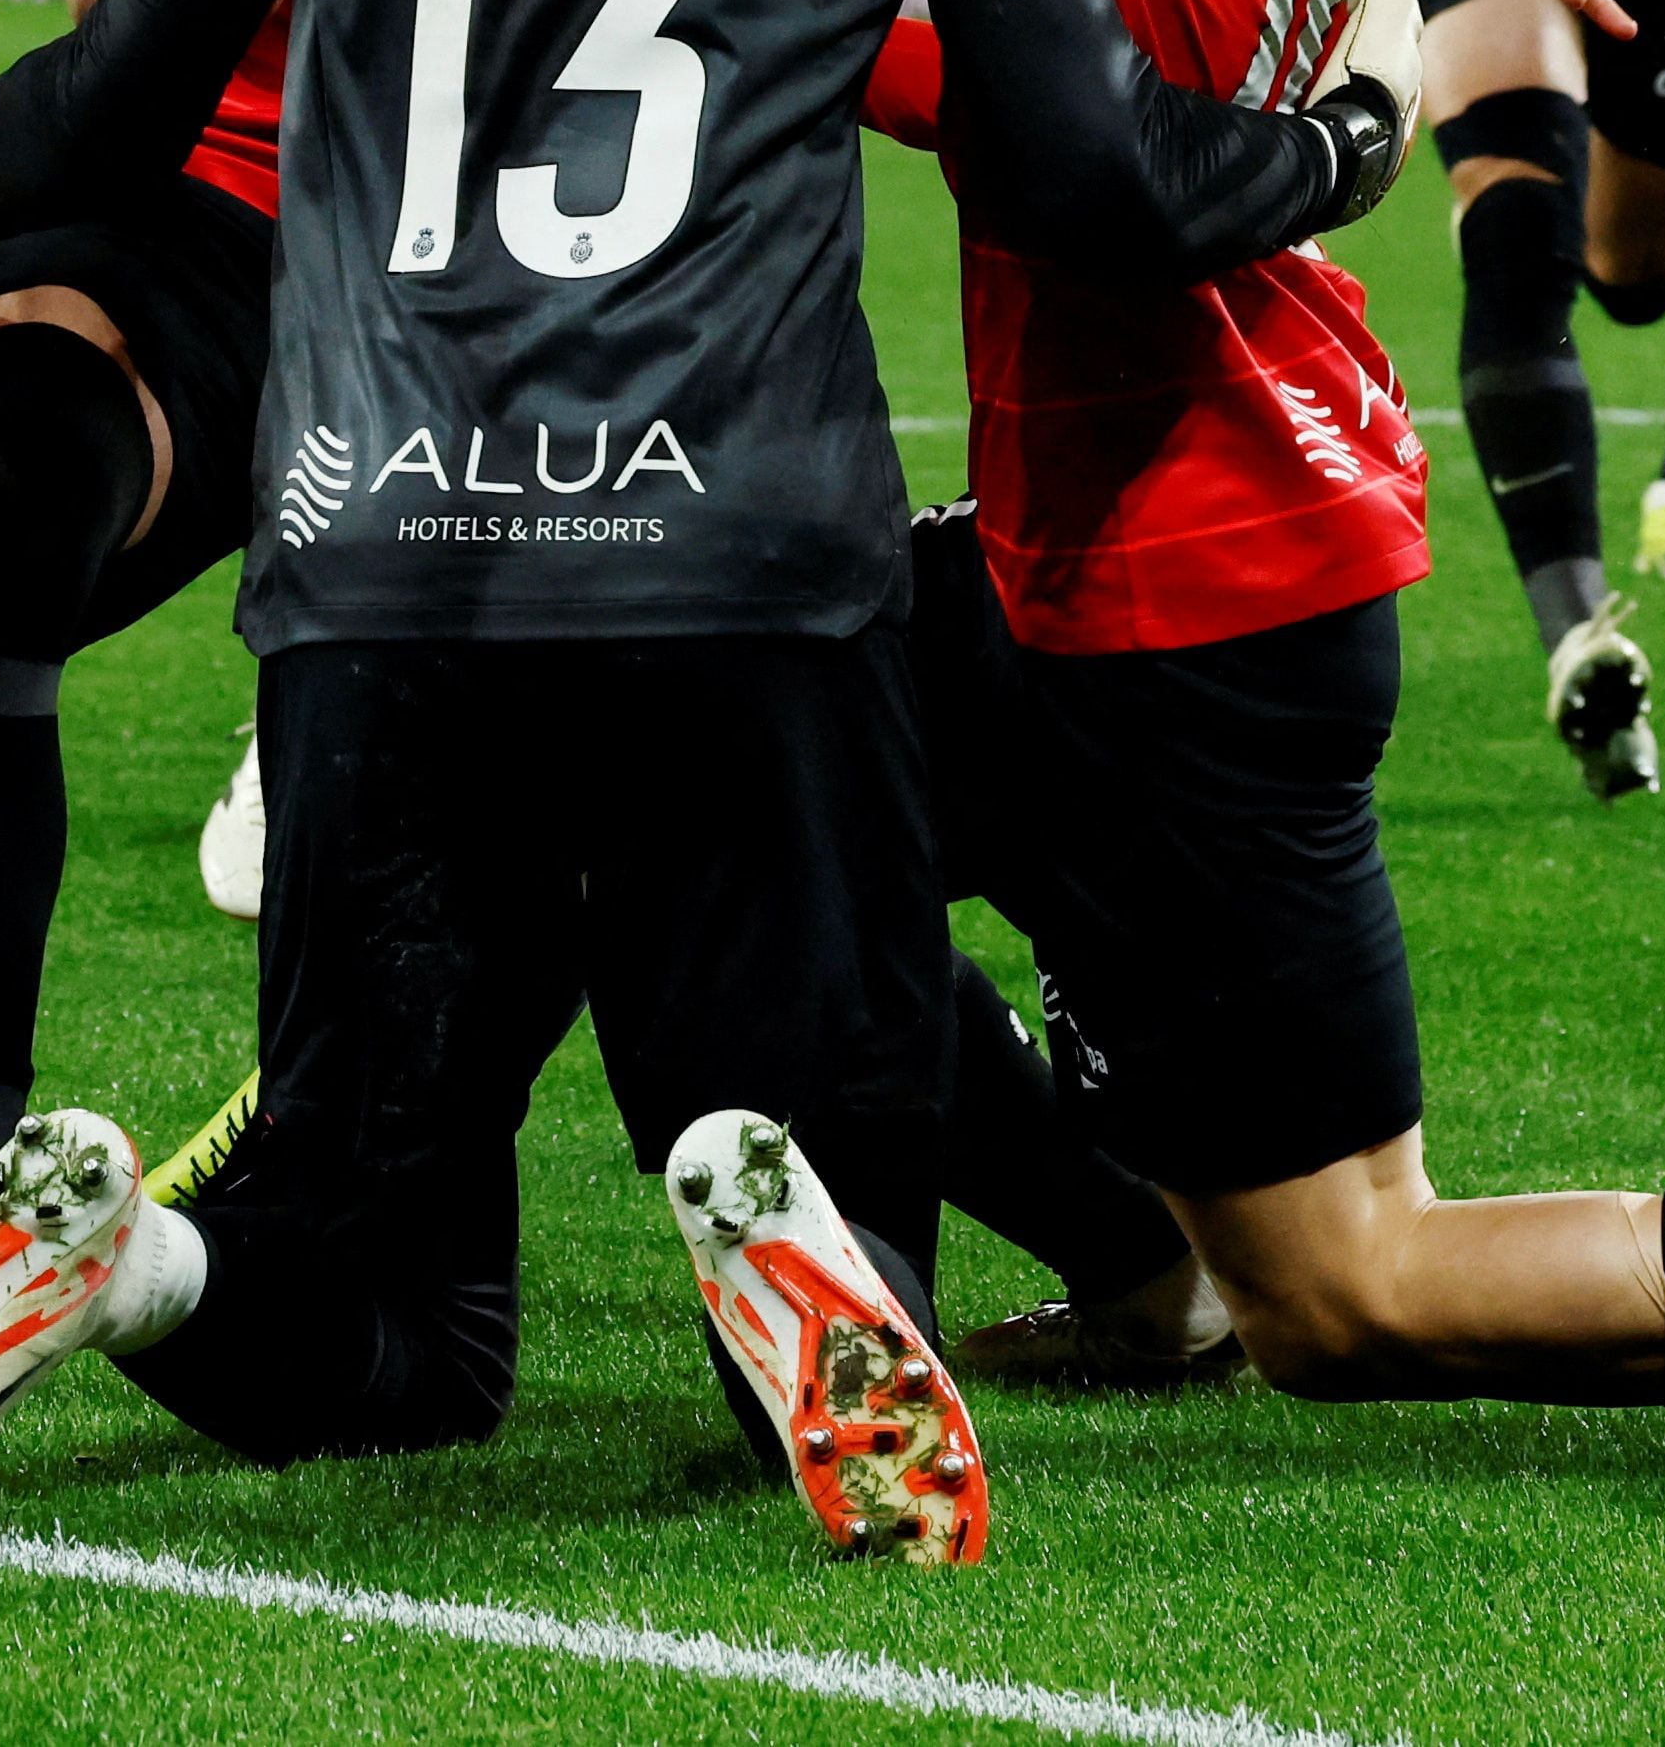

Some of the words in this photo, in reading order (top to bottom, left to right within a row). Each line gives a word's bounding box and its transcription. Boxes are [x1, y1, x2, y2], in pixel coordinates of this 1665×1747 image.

[369, 419, 706, 494] ALUA
[397, 516, 501, 542] HOTELS
[508, 517, 529, 542] &
[536, 517, 665, 543] RESORTS
